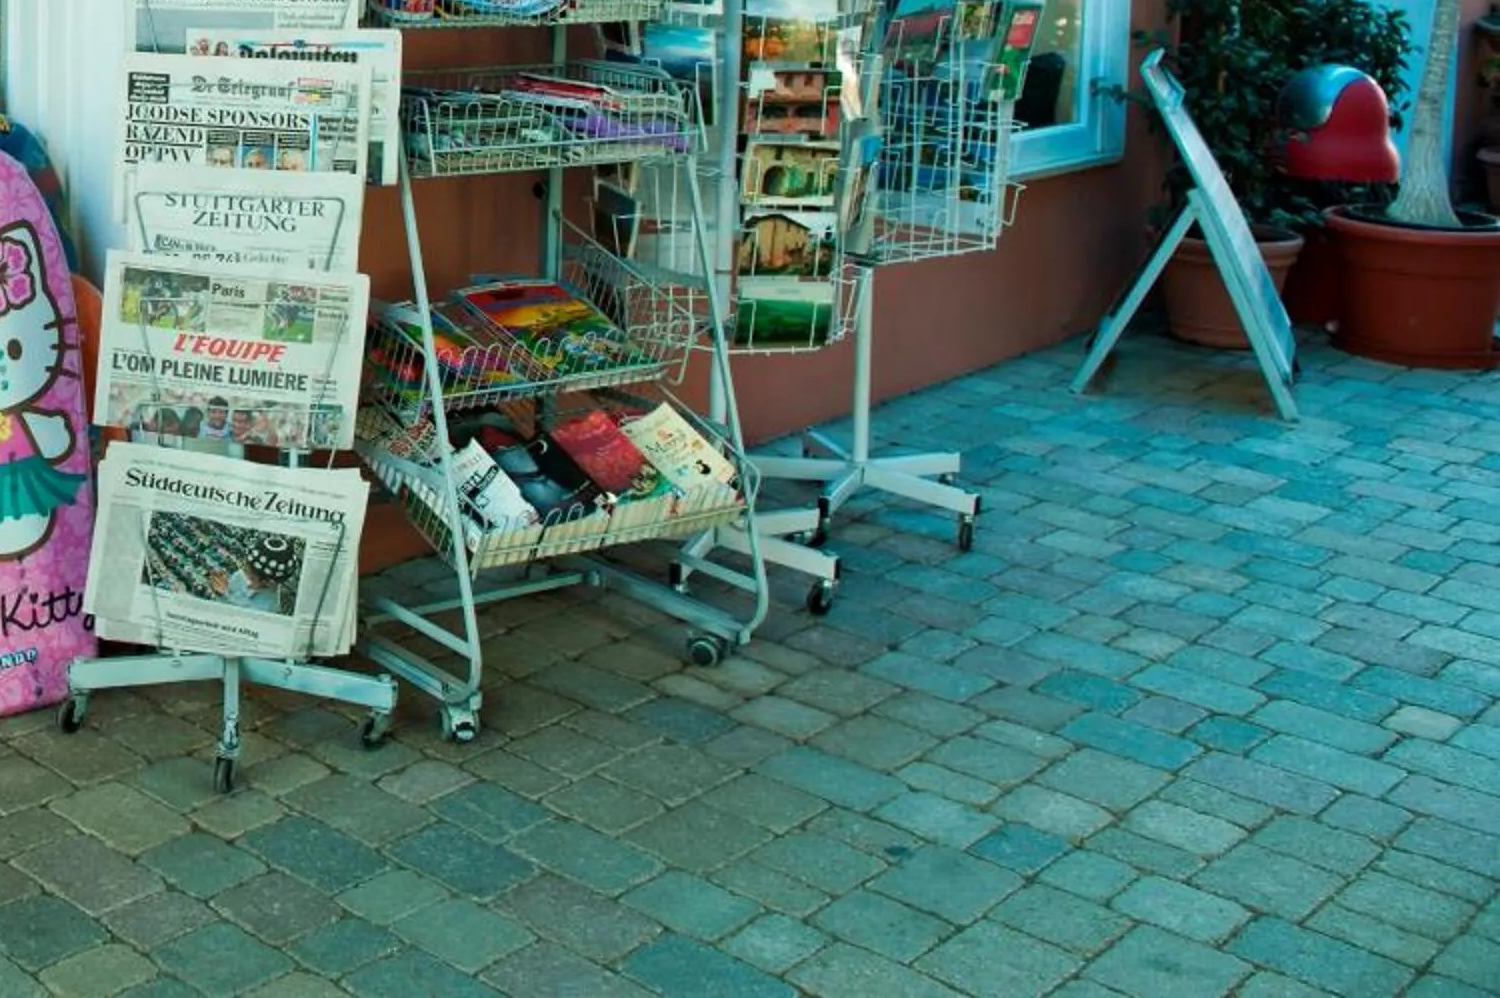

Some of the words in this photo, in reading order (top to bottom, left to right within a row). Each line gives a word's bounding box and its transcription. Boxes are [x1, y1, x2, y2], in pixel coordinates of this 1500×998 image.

[206, 108, 311, 130] SPONSORS
[125, 124, 203, 144] RAZEND
[164, 191, 325, 218] STUTTGARTER
[192, 209, 299, 233] ZEITUNG
[212, 282, 246, 299] Paris
[160, 359, 226, 384] PLEINE
[124, 467, 263, 512] Süddeutsche
[262, 491, 346, 530] Zeitung
